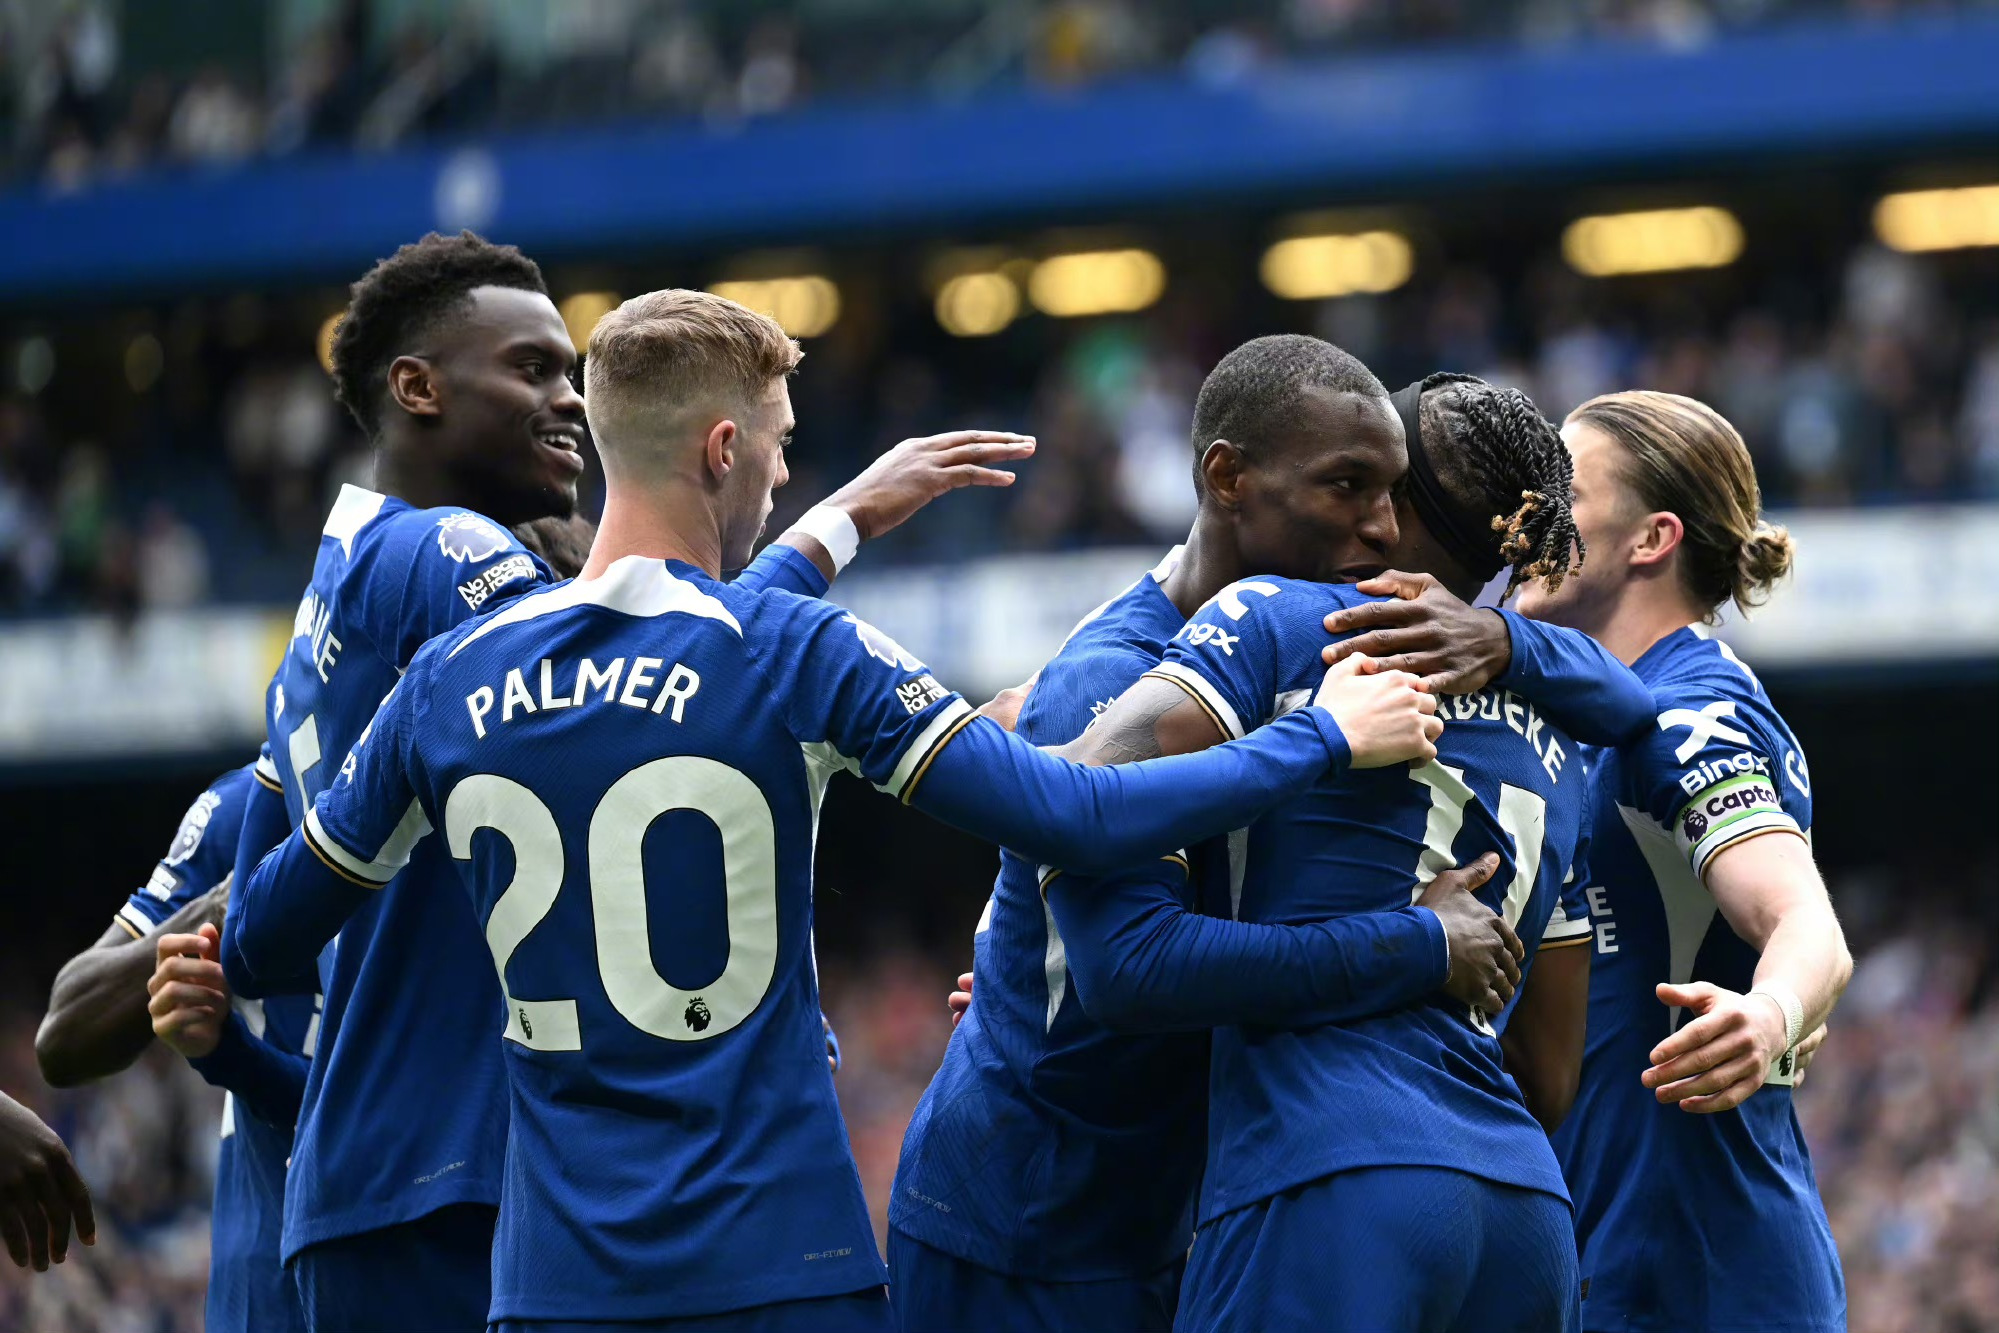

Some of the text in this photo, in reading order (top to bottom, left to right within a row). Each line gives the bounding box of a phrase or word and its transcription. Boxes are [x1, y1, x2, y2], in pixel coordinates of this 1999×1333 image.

[457, 578, 484, 601] No
[466, 586, 489, 611] for
[465, 656, 701, 740] PALMER
[895, 682, 921, 702] No
[903, 693, 929, 715] for
[1706, 785, 1776, 817] Capta
[444, 754, 779, 1052] 20
